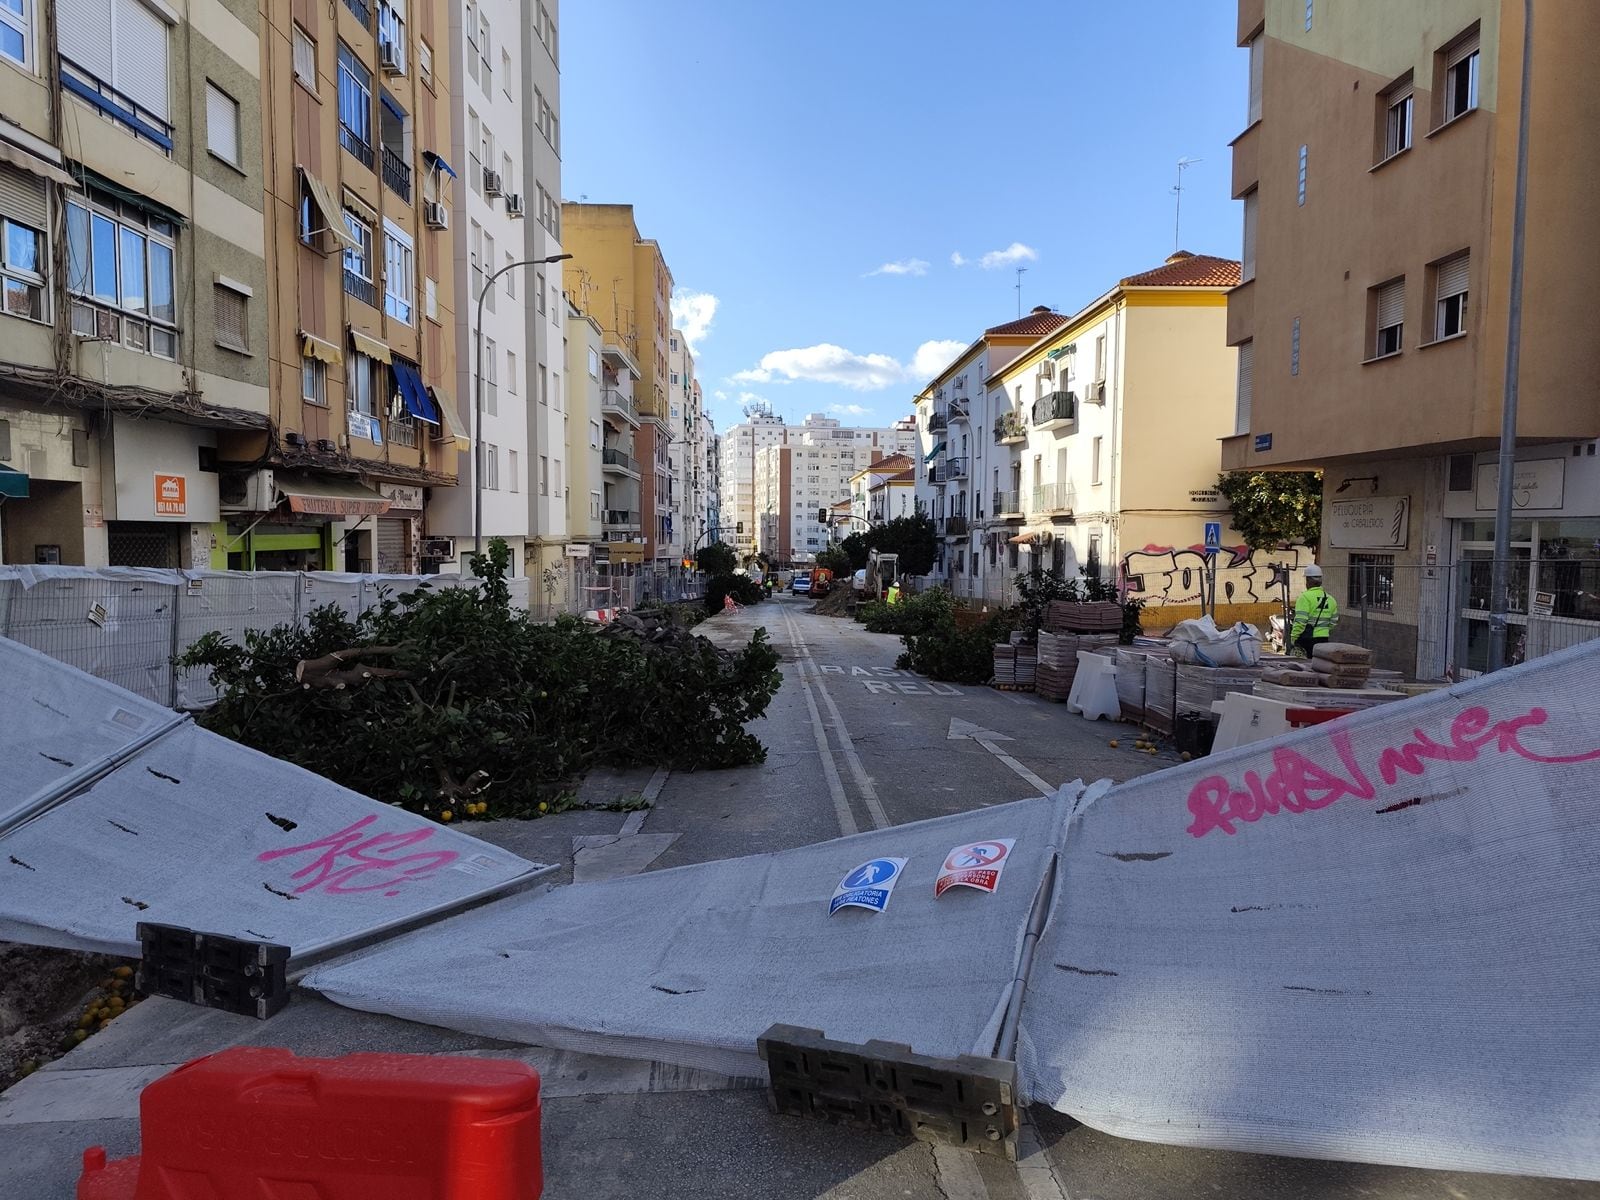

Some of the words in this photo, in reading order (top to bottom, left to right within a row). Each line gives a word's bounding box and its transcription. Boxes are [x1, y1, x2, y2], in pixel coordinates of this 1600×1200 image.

[340, 500, 361, 514] SUPER
[364, 501, 385, 514] VERDE
[1351, 518, 1384, 528] CABALLEROS
[970, 878, 989, 886] OBRA
[845, 896, 880, 905] PEATONES
